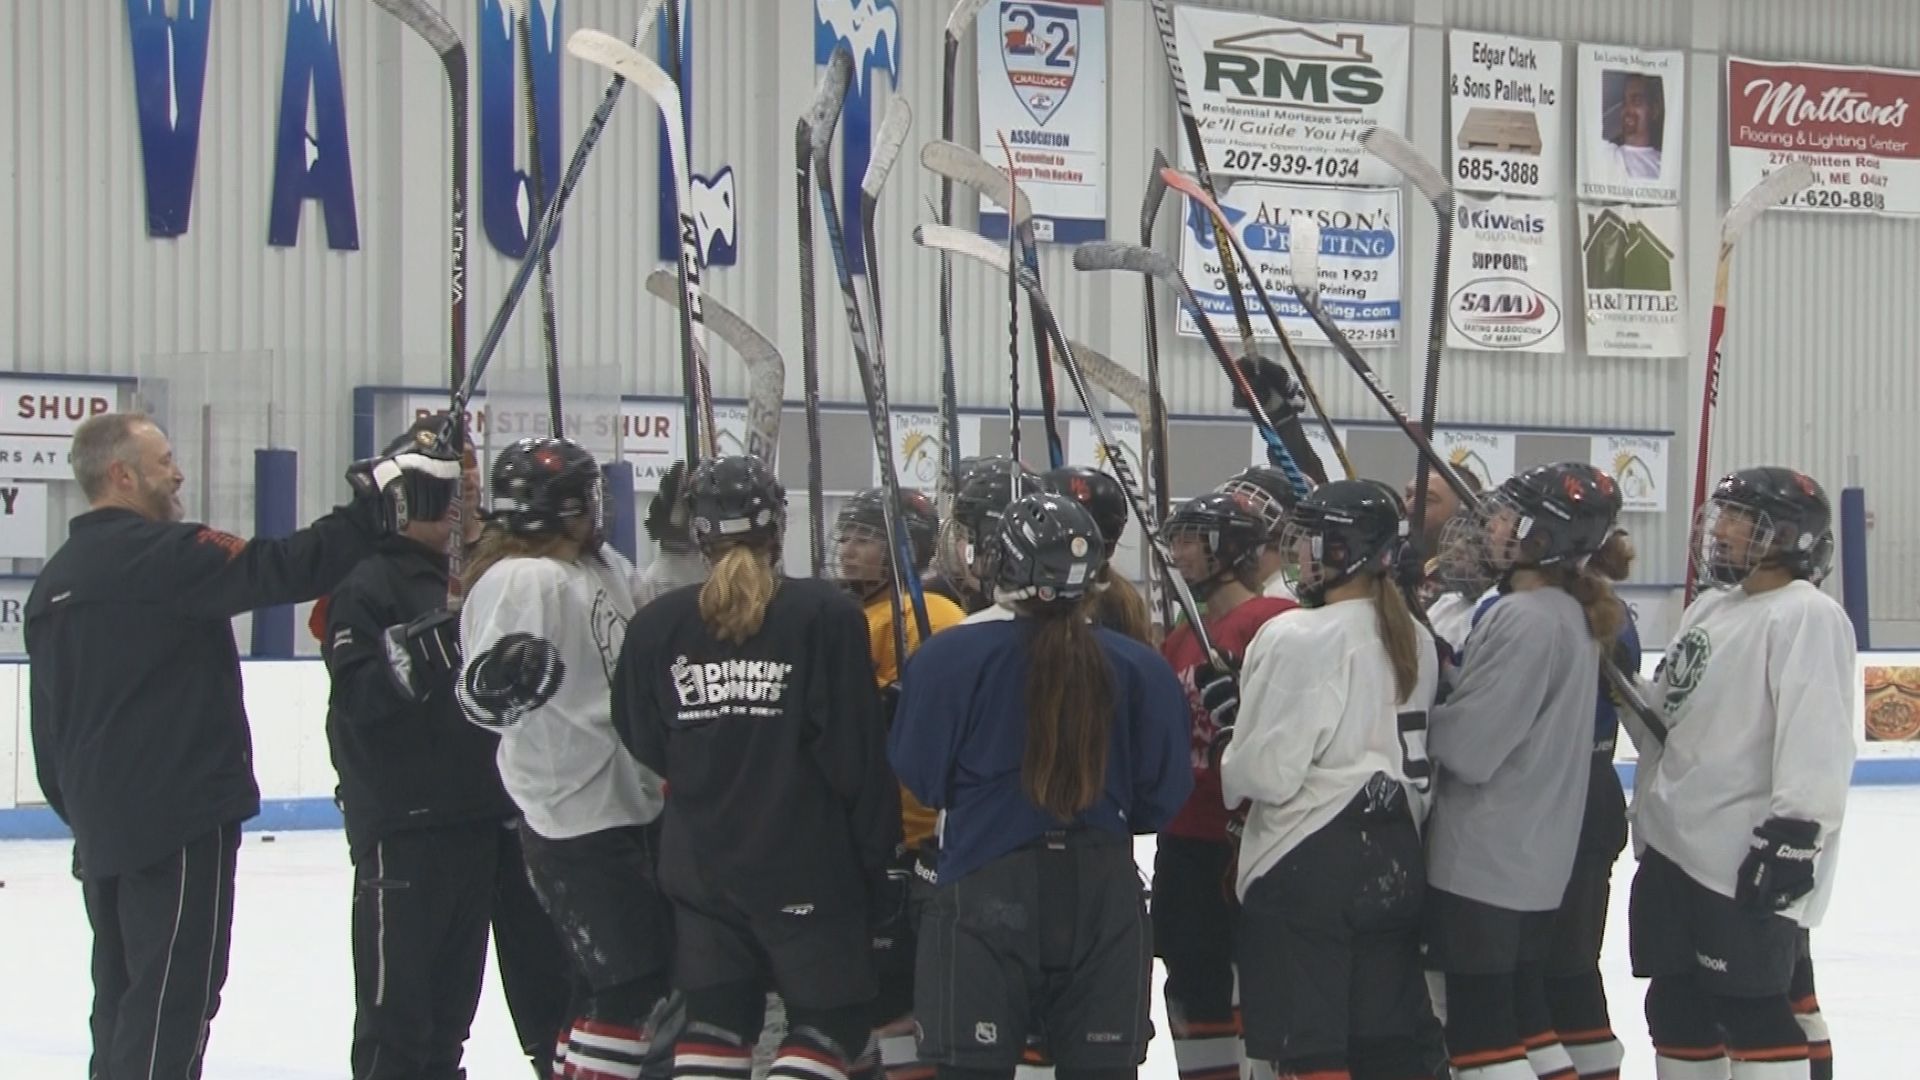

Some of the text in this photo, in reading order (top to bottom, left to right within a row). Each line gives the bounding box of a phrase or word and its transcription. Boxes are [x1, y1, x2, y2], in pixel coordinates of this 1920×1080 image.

[1045, 22, 1071, 67] 2
[1472, 41, 1537, 71] Edgar Clark
[1204, 51, 1384, 105] RMS
[1451, 74, 1555, 107] & Sons Pallett, Inc
[1202, 103, 1270, 119] Residential
[1274, 110, 1332, 125] Mortgage
[1744, 79, 1909, 127] Mattson's
[1240, 121, 1296, 137] Guide
[1304, 126, 1336, 140] You
[1740, 126, 1793, 147] Flooring
[1796, 131, 1806, 145] &
[1809, 132, 1866, 150] Lighting
[1224, 149, 1360, 178] 207-939-1034
[1458, 156, 1539, 185] 685-3888
[1829, 173, 1850, 185] ME
[1471, 209, 1544, 233] Kiwanis
[680, 212, 704, 325] CCM
[1472, 252, 1528, 272] SUPPORTS
[1343, 269, 1378, 282] 1932
[1624, 294, 1678, 312] TITLE
